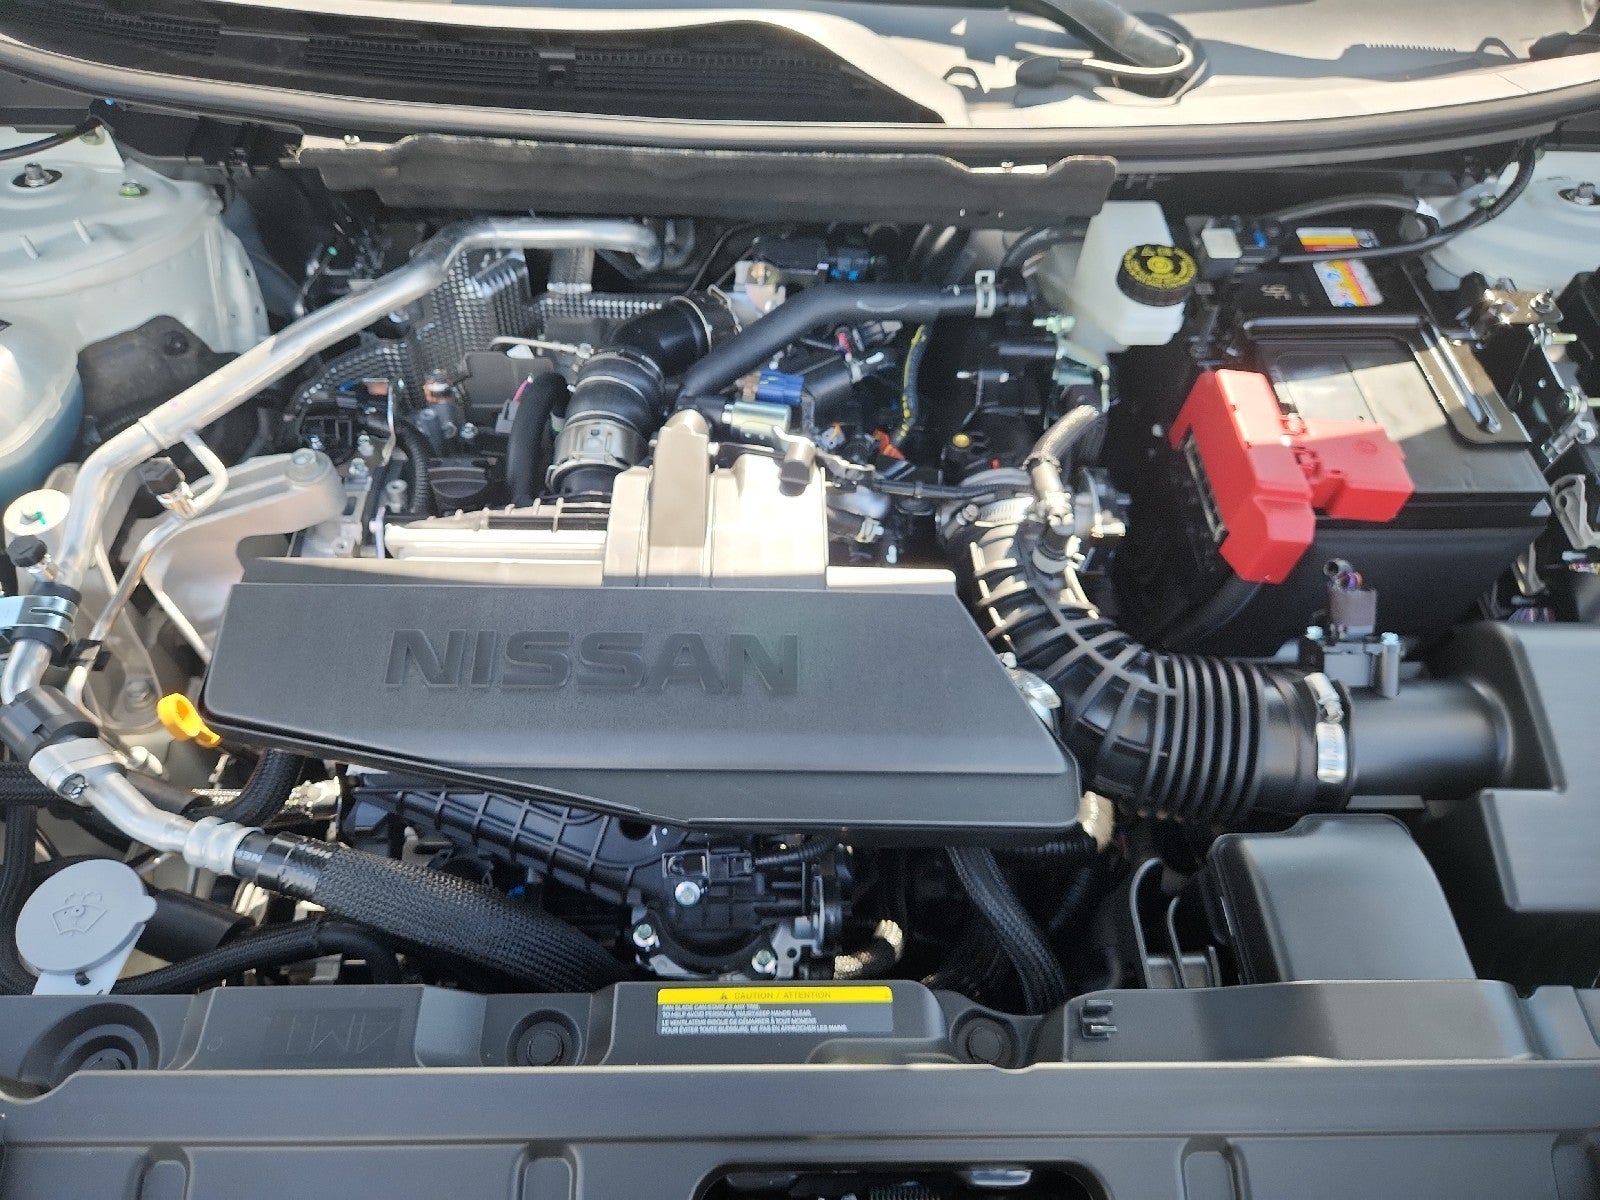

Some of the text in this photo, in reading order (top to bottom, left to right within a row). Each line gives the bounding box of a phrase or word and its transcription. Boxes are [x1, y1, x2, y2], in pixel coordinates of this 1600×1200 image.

[383, 628, 800, 695] NISSAN
[734, 991, 773, 1000] CAUTION
[783, 990, 831, 999] ATTENTION
[662, 1018, 669, 1026] LE
[661, 1026, 678, 1034] POUR
[759, 1025, 771, 1033] PAS
[817, 1024, 828, 1032] LES
